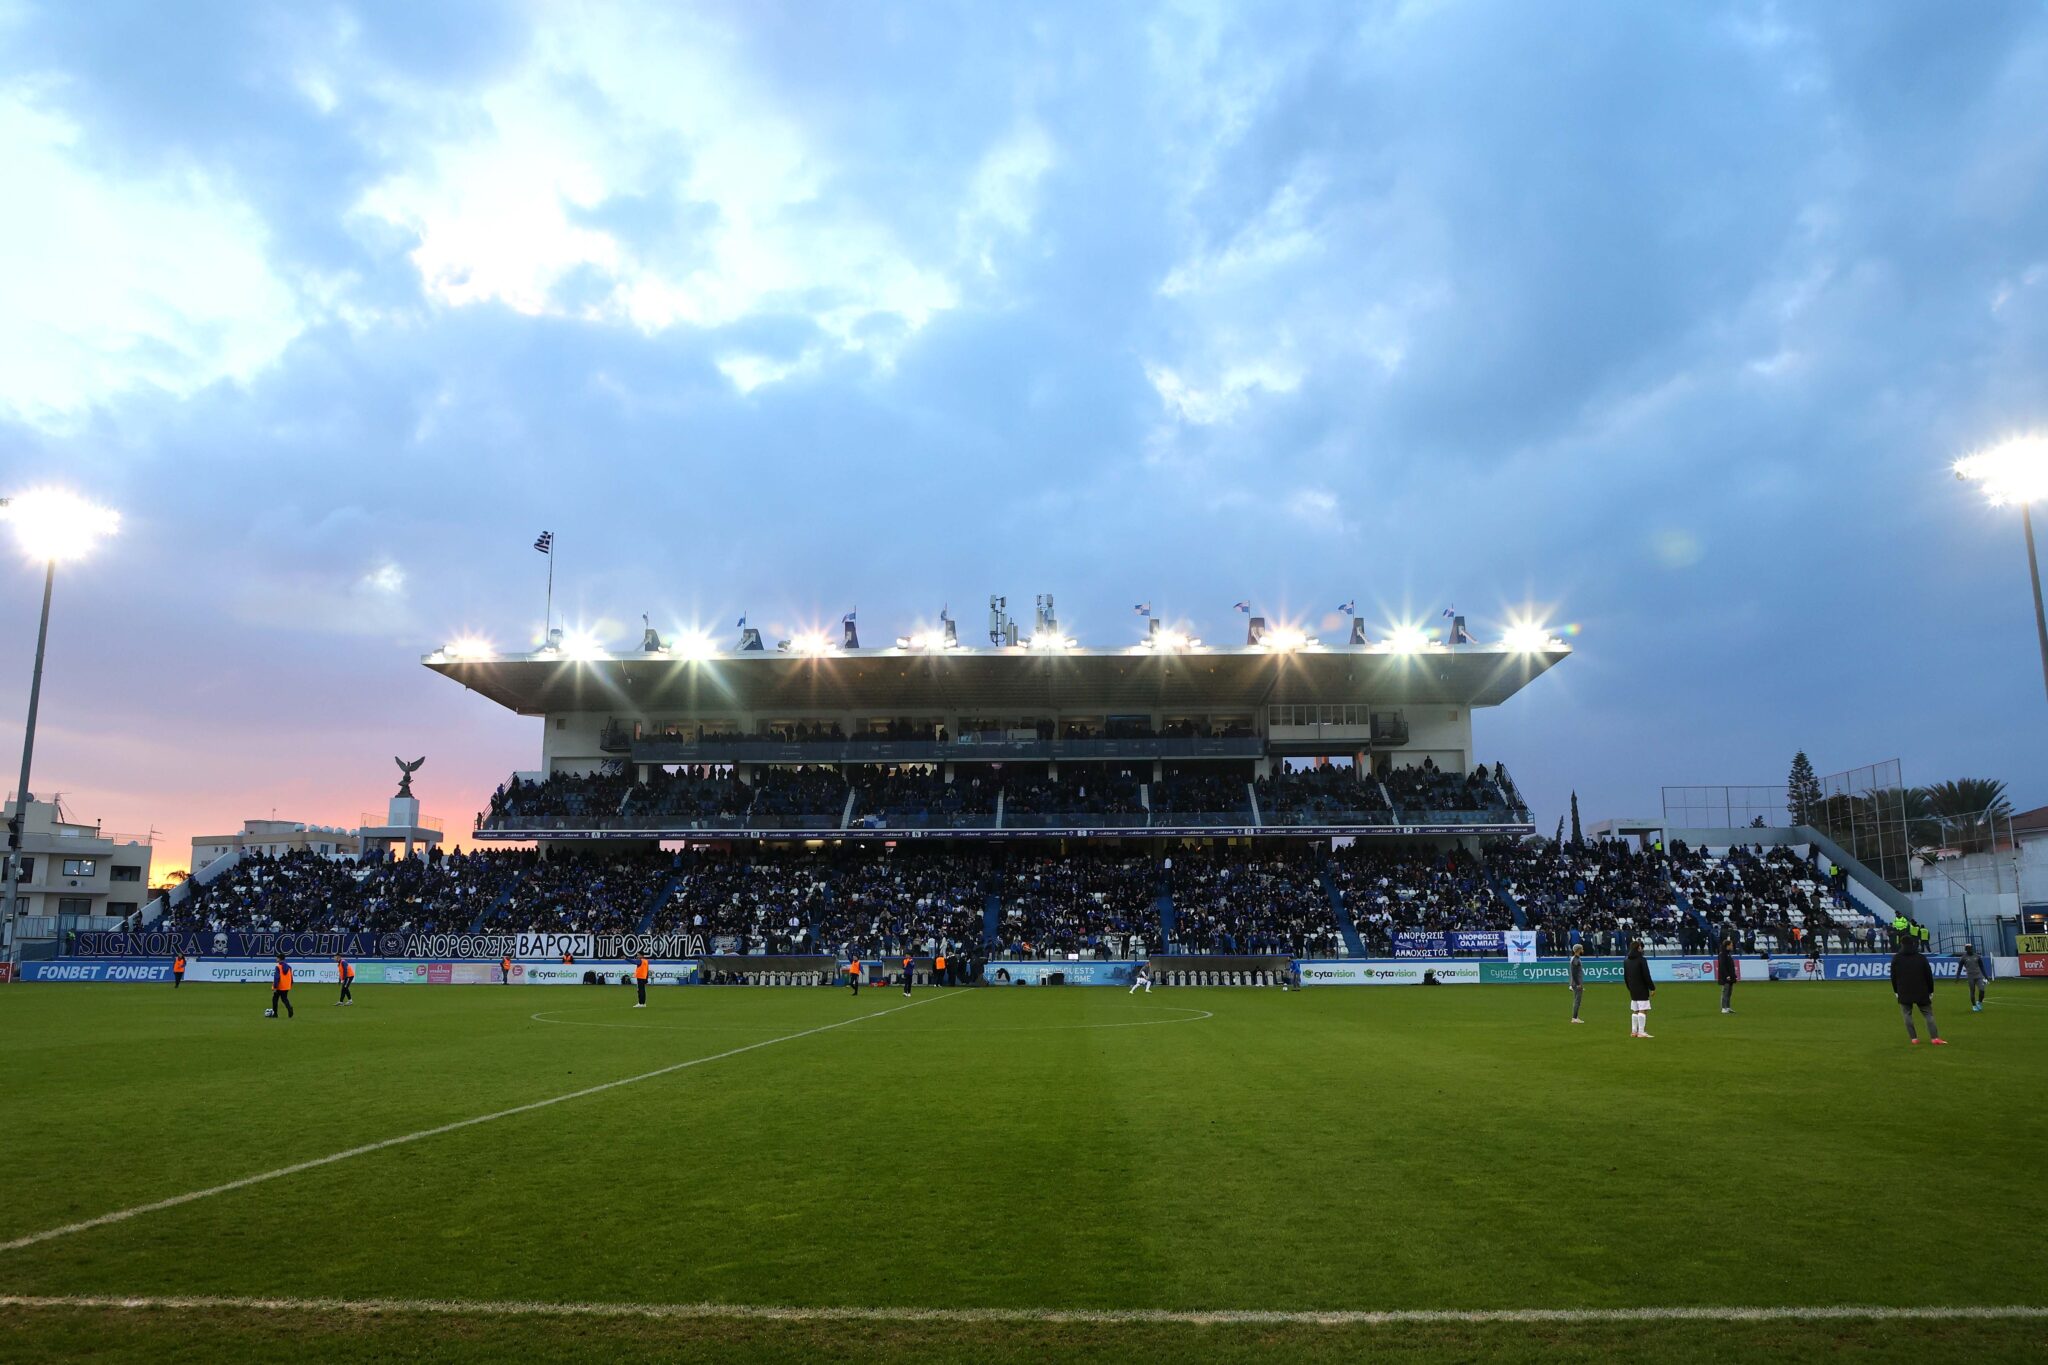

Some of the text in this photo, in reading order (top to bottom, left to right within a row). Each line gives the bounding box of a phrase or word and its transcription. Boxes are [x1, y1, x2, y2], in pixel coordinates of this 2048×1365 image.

[78, 932, 203, 956] SIGNORA
[239, 933, 366, 956] VECCHIA
[404, 933, 516, 957] ΑΝΟΡΘΩΣΙΣ
[519, 935, 590, 957] ΒΑΡΩΣΙ
[597, 934, 706, 957] ΠΡΟΣΦΥΓΙΑ
[37, 966, 169, 980] FONBET FONBET
[538, 969, 577, 979] cytavision
[1314, 969, 1356, 979] cytavision
[1375, 969, 1417, 979] cytavision
[1437, 968, 1479, 979] cytavision
[1836, 962, 1891, 977] FONBE
